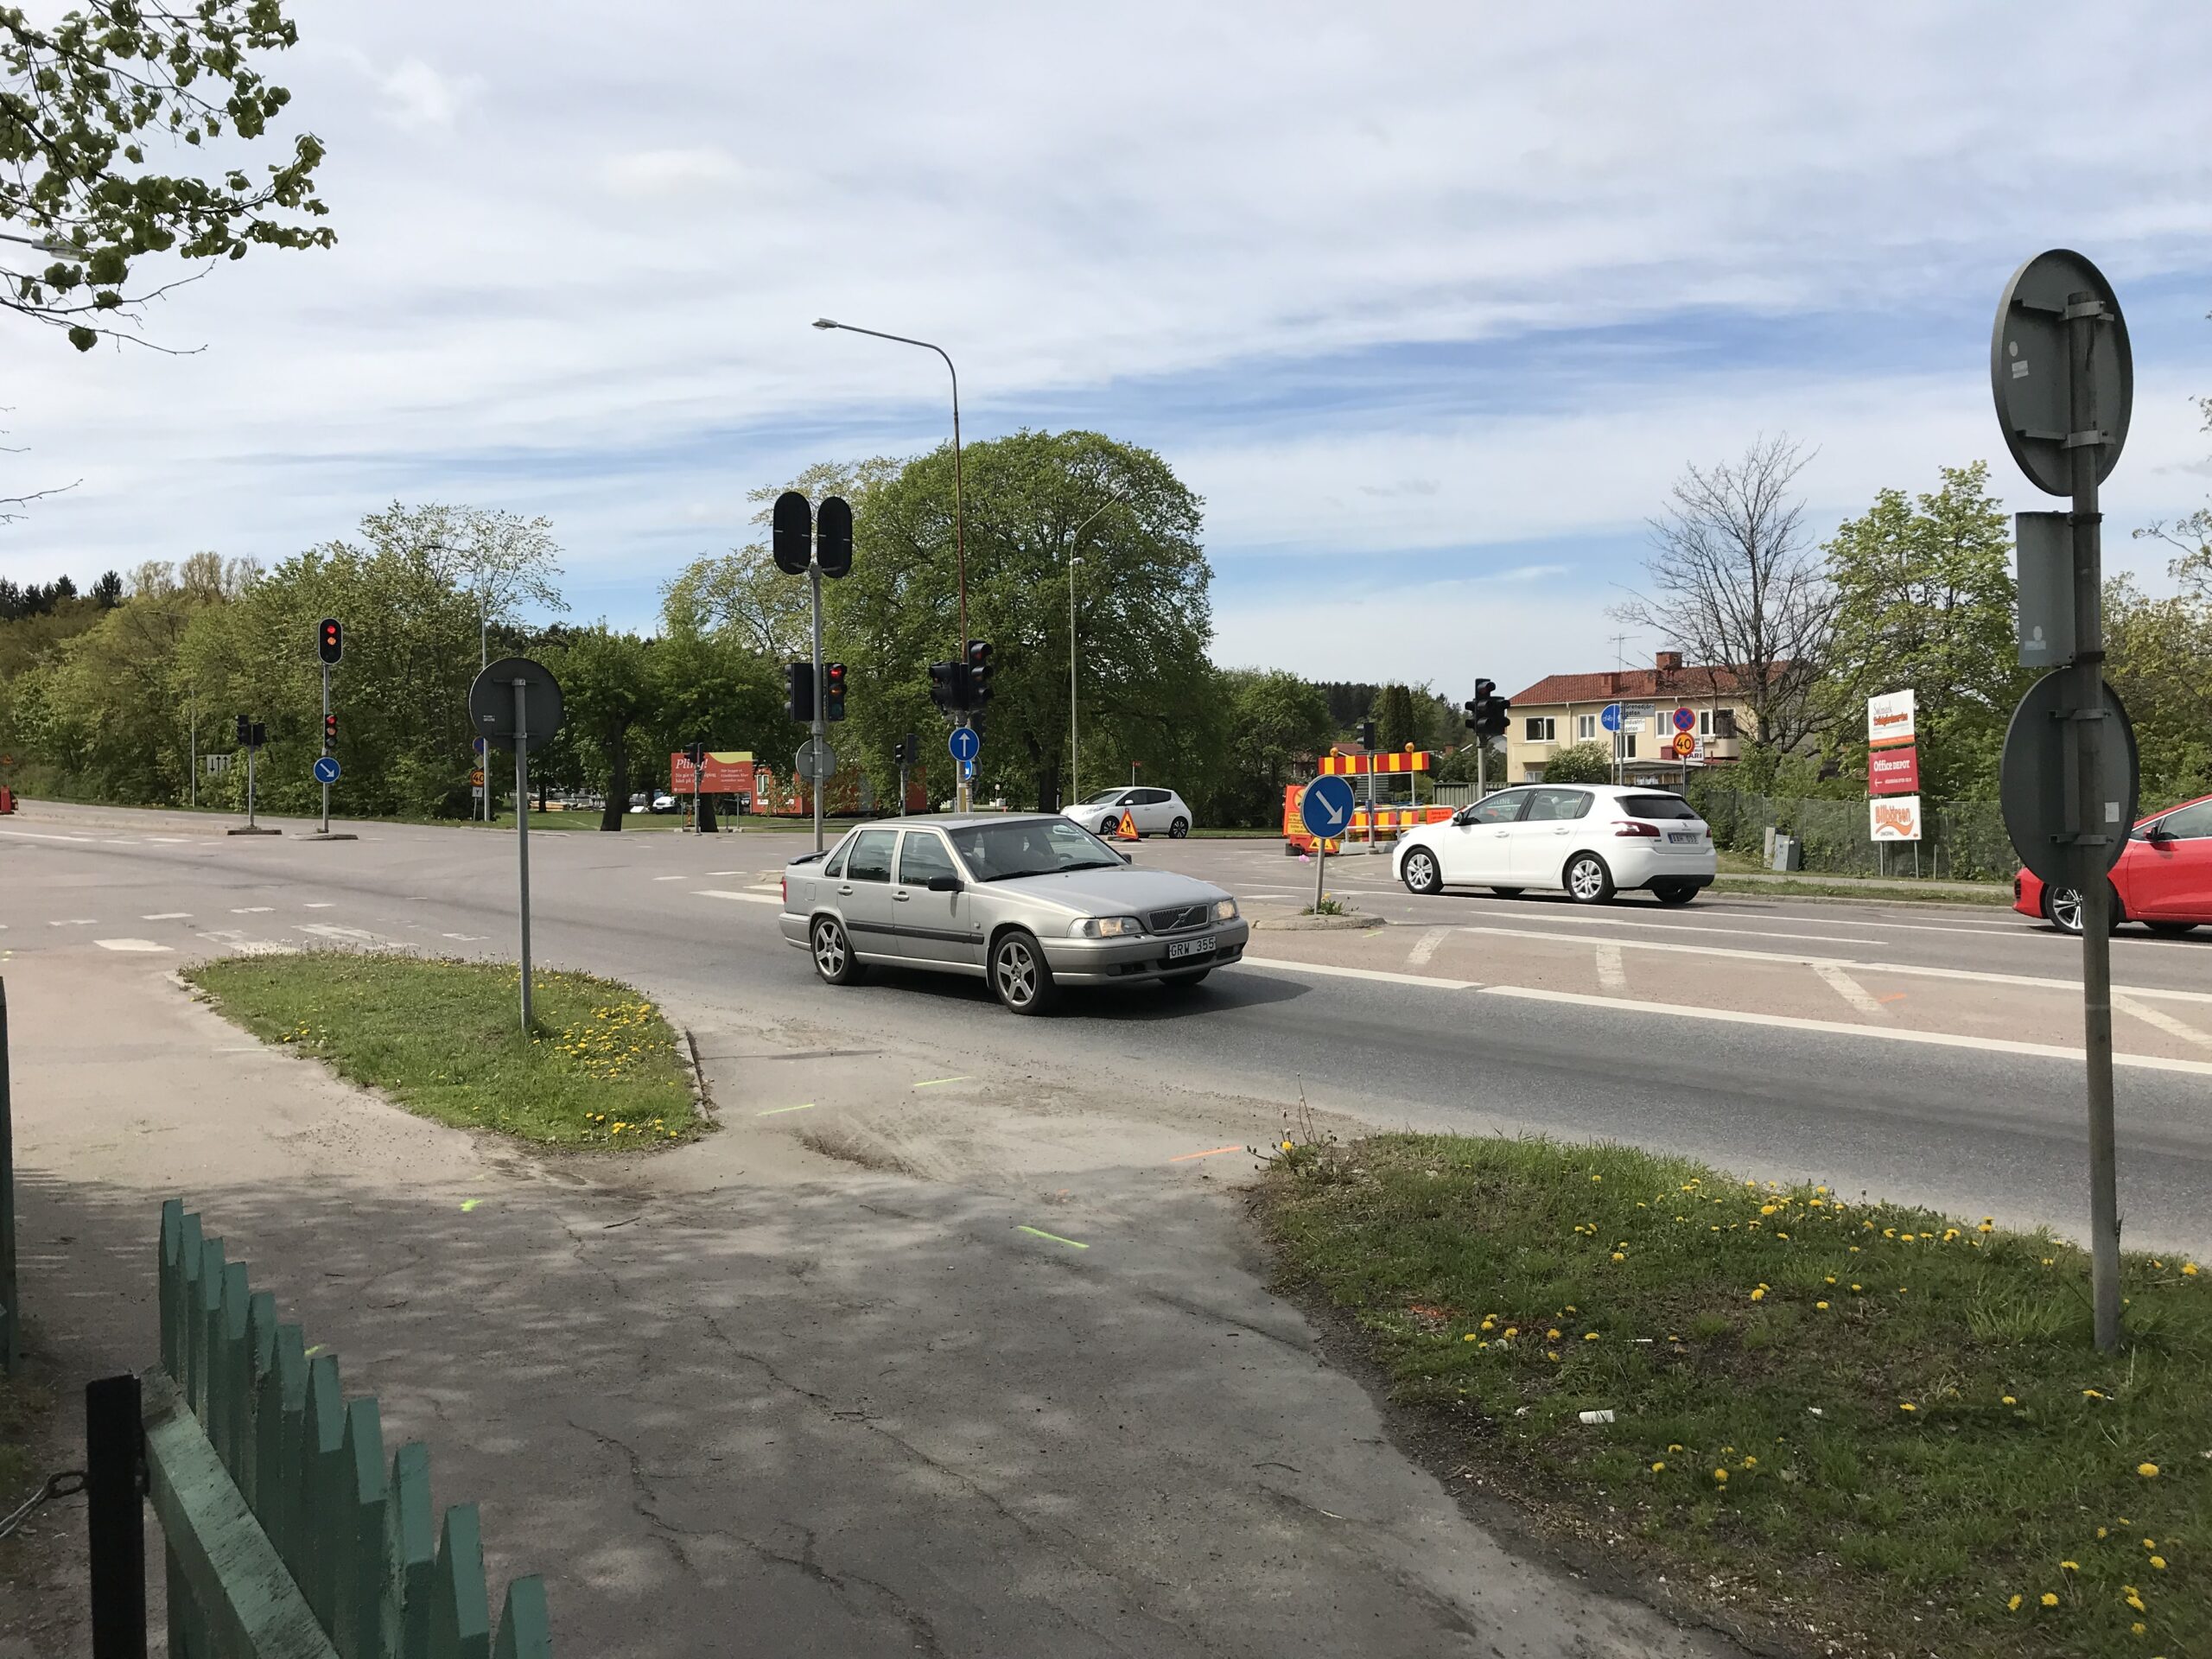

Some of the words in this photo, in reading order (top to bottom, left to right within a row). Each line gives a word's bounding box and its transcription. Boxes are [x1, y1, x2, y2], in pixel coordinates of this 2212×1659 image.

[1676, 738, 1692, 750] 40
[1873, 760, 1893, 772] Office
[1892, 760, 1910, 770] DEPOT
[1172, 943, 1190, 957] GRW
[1197, 938, 1214, 951] 355
